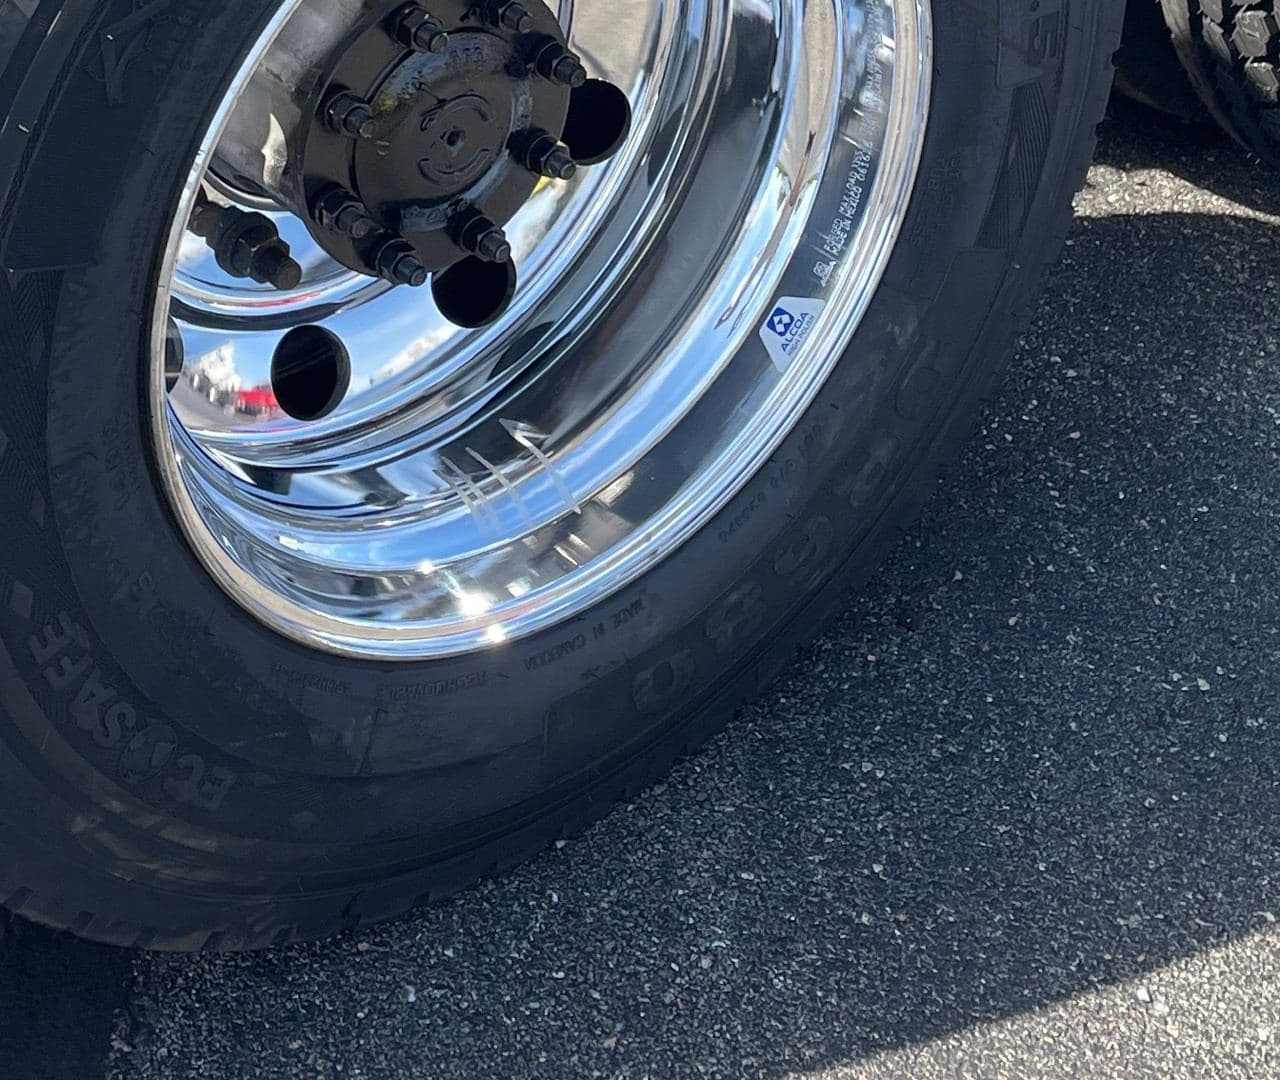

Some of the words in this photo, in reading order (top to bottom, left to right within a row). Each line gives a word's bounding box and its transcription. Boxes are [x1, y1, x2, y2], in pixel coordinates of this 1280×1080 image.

[781, 313, 808, 352] ALCOA
[786, 338, 800, 355] HIGH
[797, 314, 814, 338] POLISH
